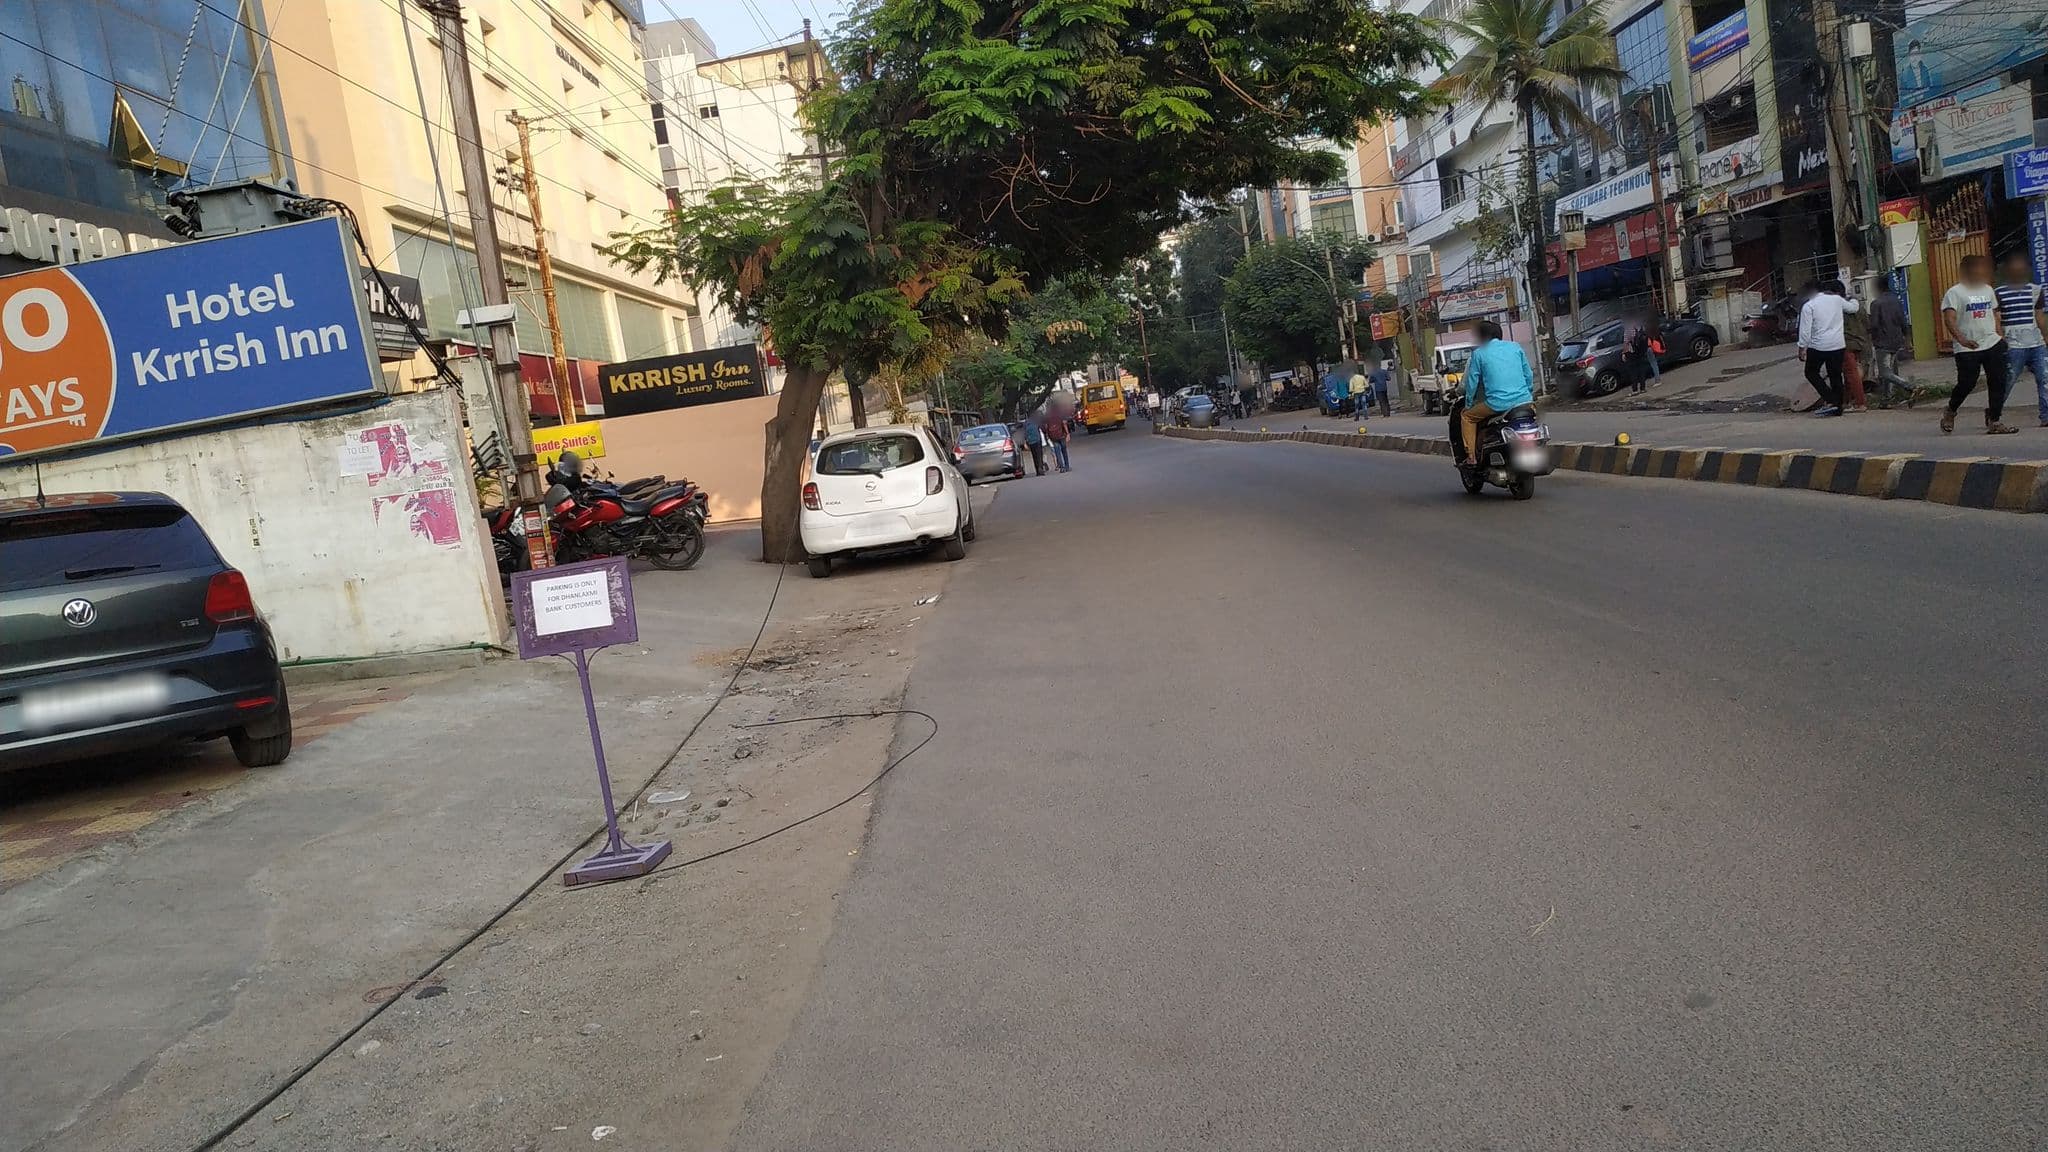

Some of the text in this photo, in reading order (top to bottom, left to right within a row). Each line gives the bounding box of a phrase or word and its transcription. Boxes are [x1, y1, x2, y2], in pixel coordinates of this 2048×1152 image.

[1570, 162, 1671, 210] SOFTWARE TECHNOLOES
[166, 273, 295, 329] Hotel
[0, 287, 69, 353] O
[132, 323, 349, 387] Krrish Inn
[609, 359, 752, 394] KRRISH Inn
[675, 383, 712, 396] Luxury
[546, 583, 574, 593] PARKING
[581, 579, 598, 589] ONLY
[547, 590, 598, 603] FOR DHANLAXMI
[545, 599, 602, 614] BANK CUSTOMERS
